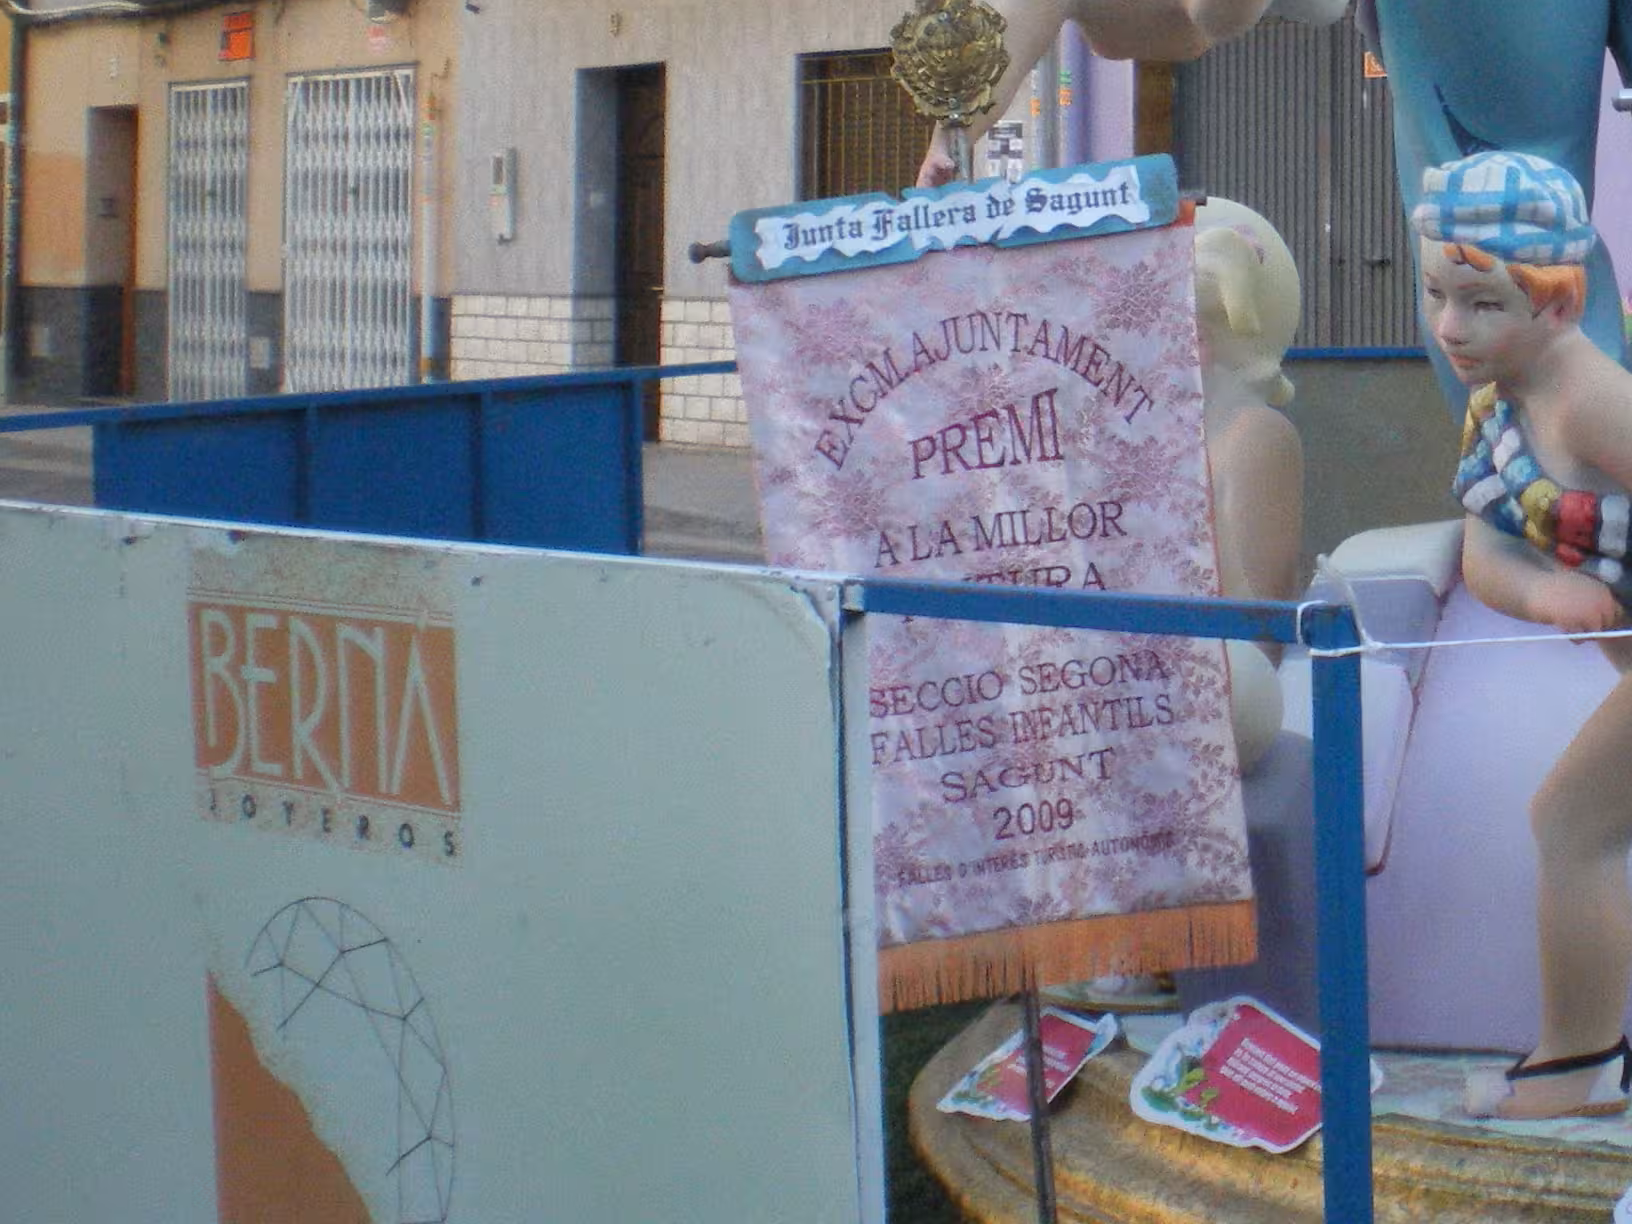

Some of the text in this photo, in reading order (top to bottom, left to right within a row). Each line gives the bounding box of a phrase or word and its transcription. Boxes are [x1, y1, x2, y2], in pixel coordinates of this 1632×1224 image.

[782, 179, 1131, 251] Junta Fallera de Sagunt
[911, 311, 1155, 426] AJUNTAMENT
[909, 387, 1065, 480] PREMI
[874, 500, 1129, 569] A LA MILLOR
[201, 608, 454, 806] BERNA
[868, 648, 1170, 720] SECCIO SEGONA
[870, 694, 1176, 765] FALLES INFANTILS
[939, 747, 1118, 804] SAGUNT
[206, 788, 457, 858] JOYEROS
[993, 797, 1075, 841] 2009
